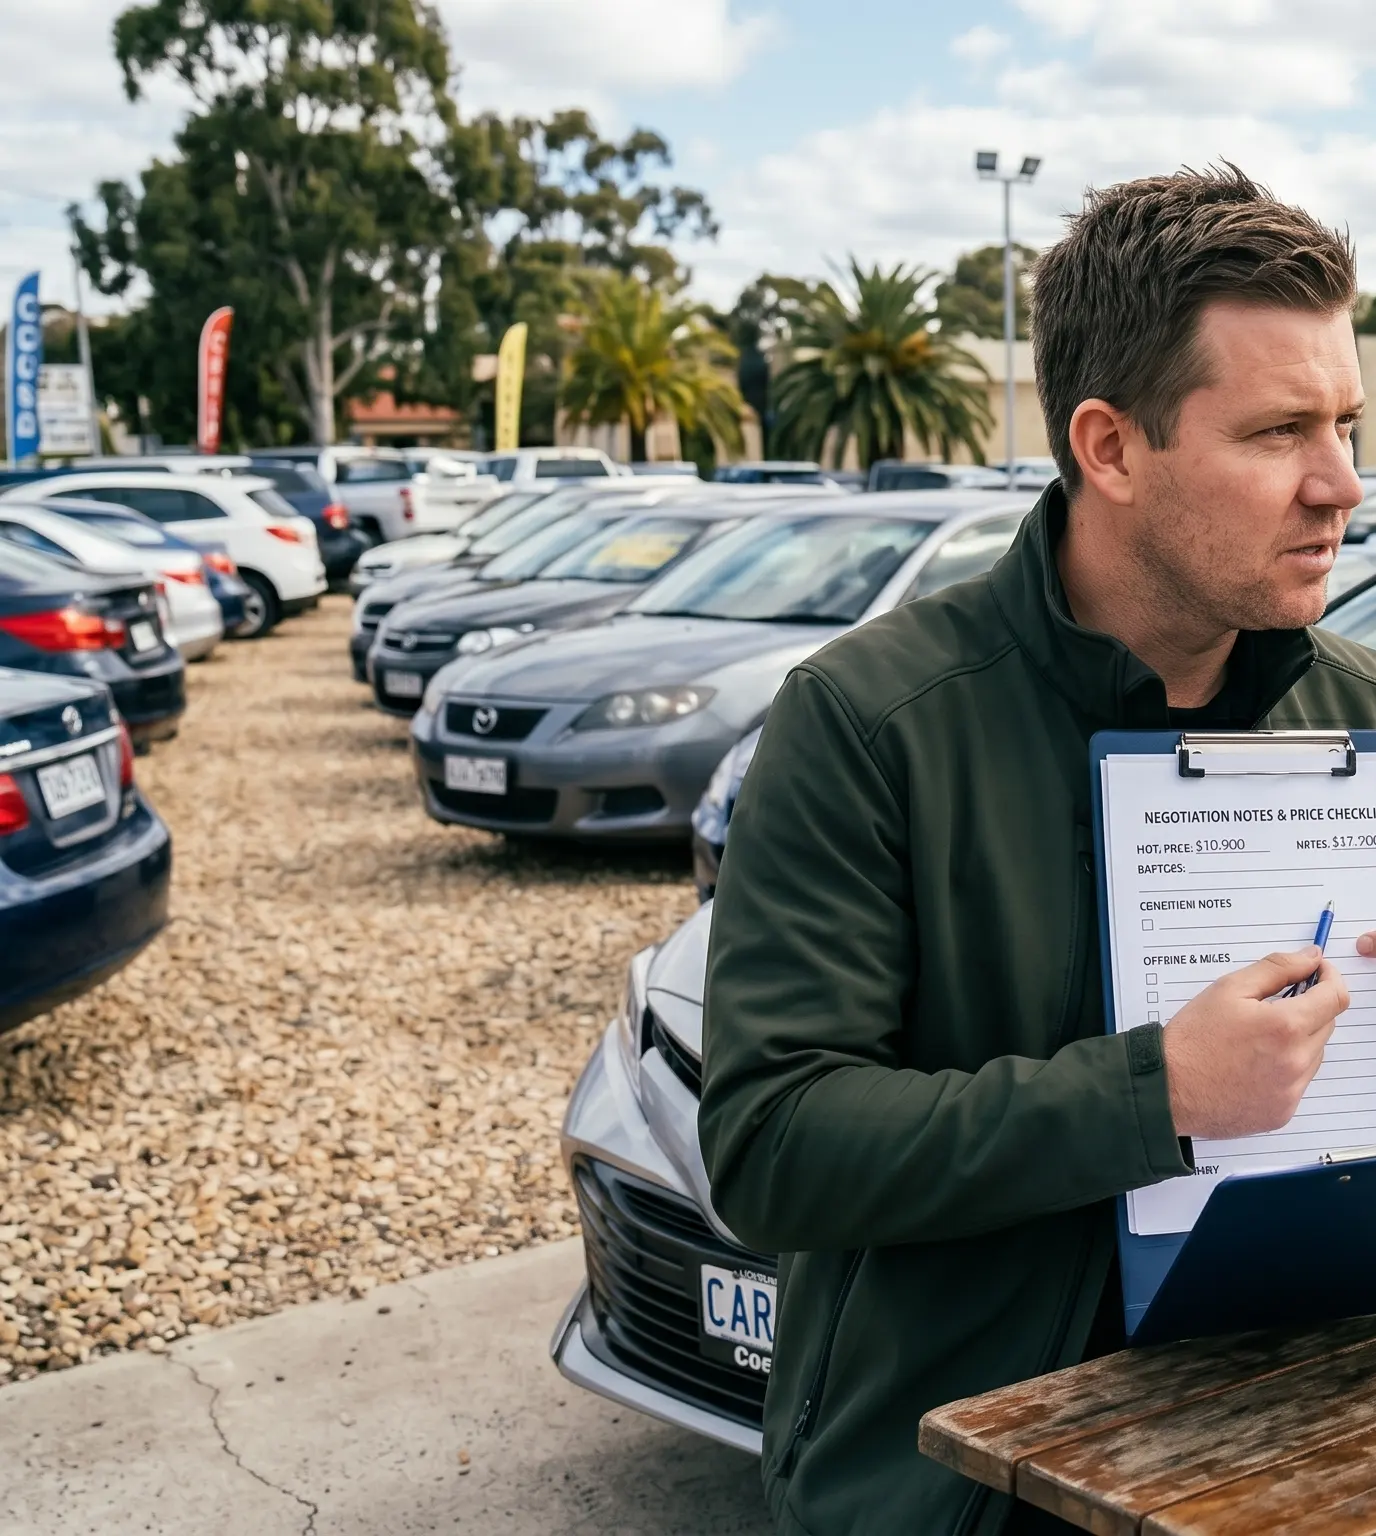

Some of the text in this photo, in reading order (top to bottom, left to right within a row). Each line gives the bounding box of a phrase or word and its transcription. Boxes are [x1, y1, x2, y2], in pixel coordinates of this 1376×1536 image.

[1144, 810, 1230, 824] NEGOTIATION
[1233, 809, 1274, 822] NOTES
[1277, 809, 1287, 821] &
[1290, 808, 1324, 821] PRICE
[1199, 898, 1232, 909] NOTES
[1189, 954, 1198, 964] &
[707, 1277, 774, 1342] CAR
